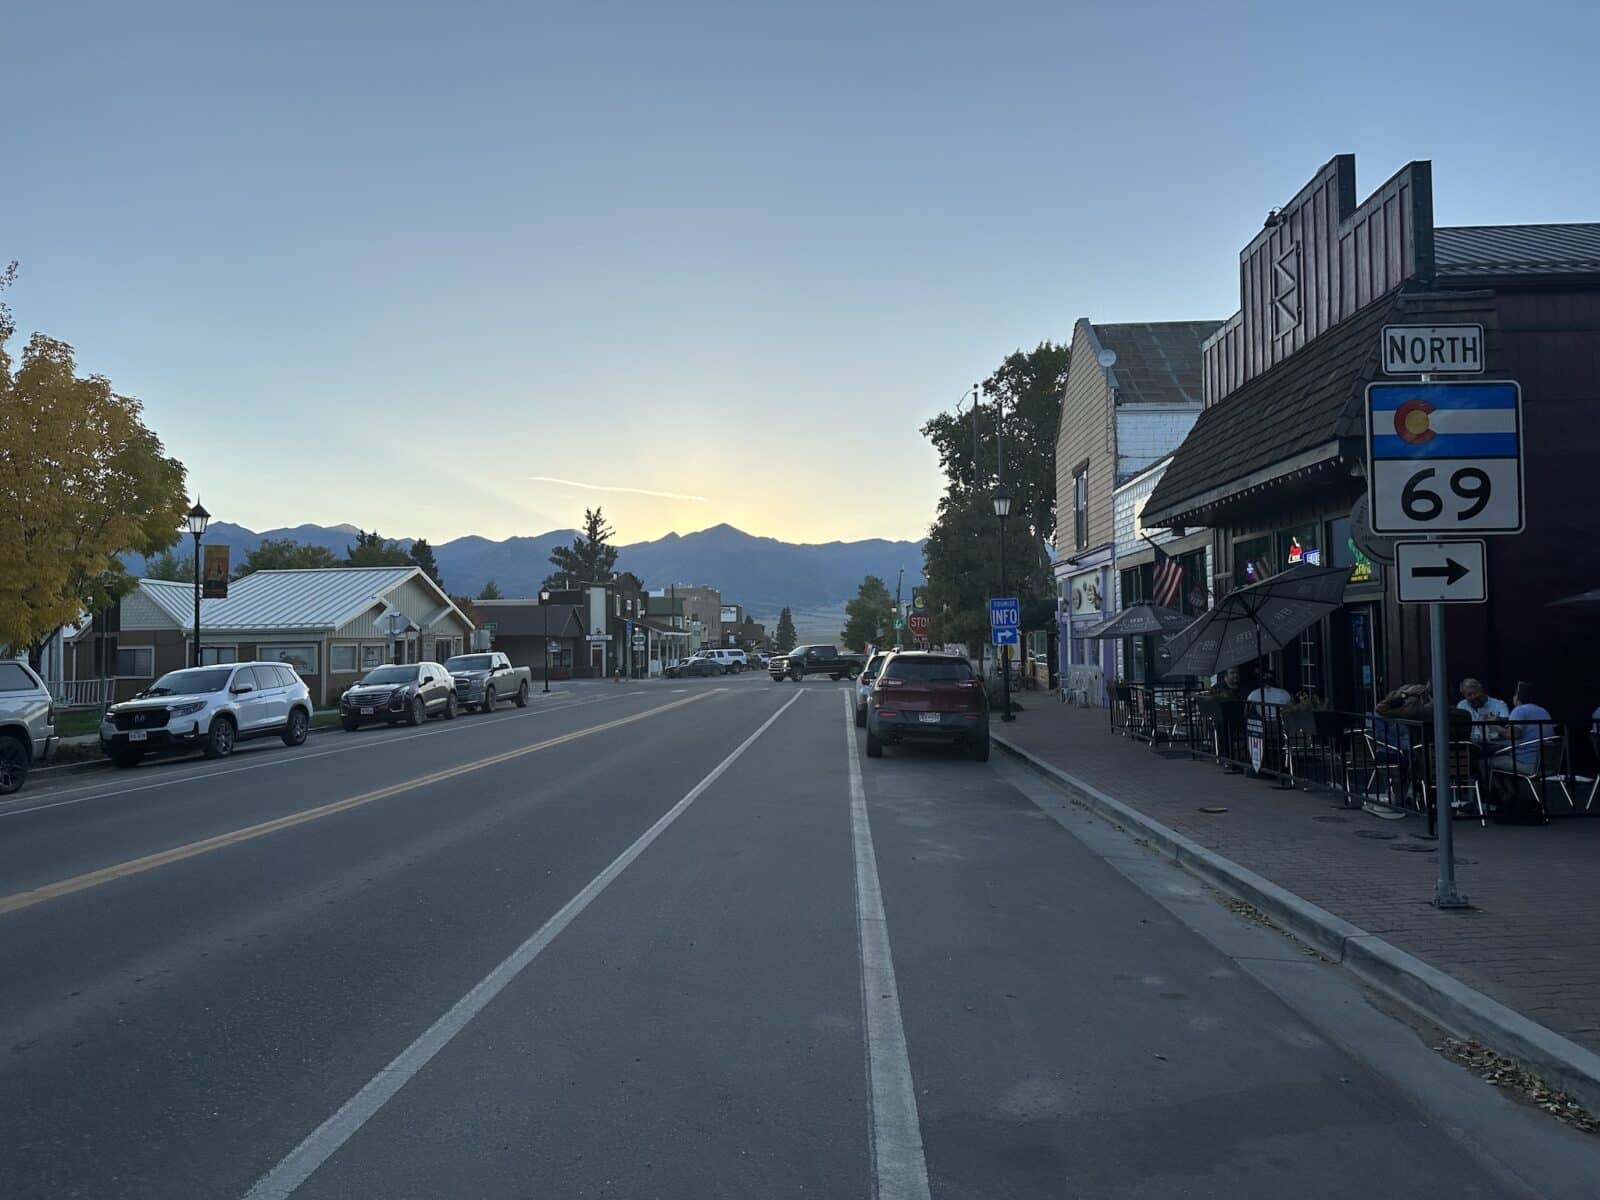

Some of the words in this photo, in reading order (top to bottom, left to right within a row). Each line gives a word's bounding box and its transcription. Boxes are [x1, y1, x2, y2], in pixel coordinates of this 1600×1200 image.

[1388, 335, 1479, 365] NORTH
[1400, 467, 1492, 522] 69
[992, 608, 1017, 625] INFO
